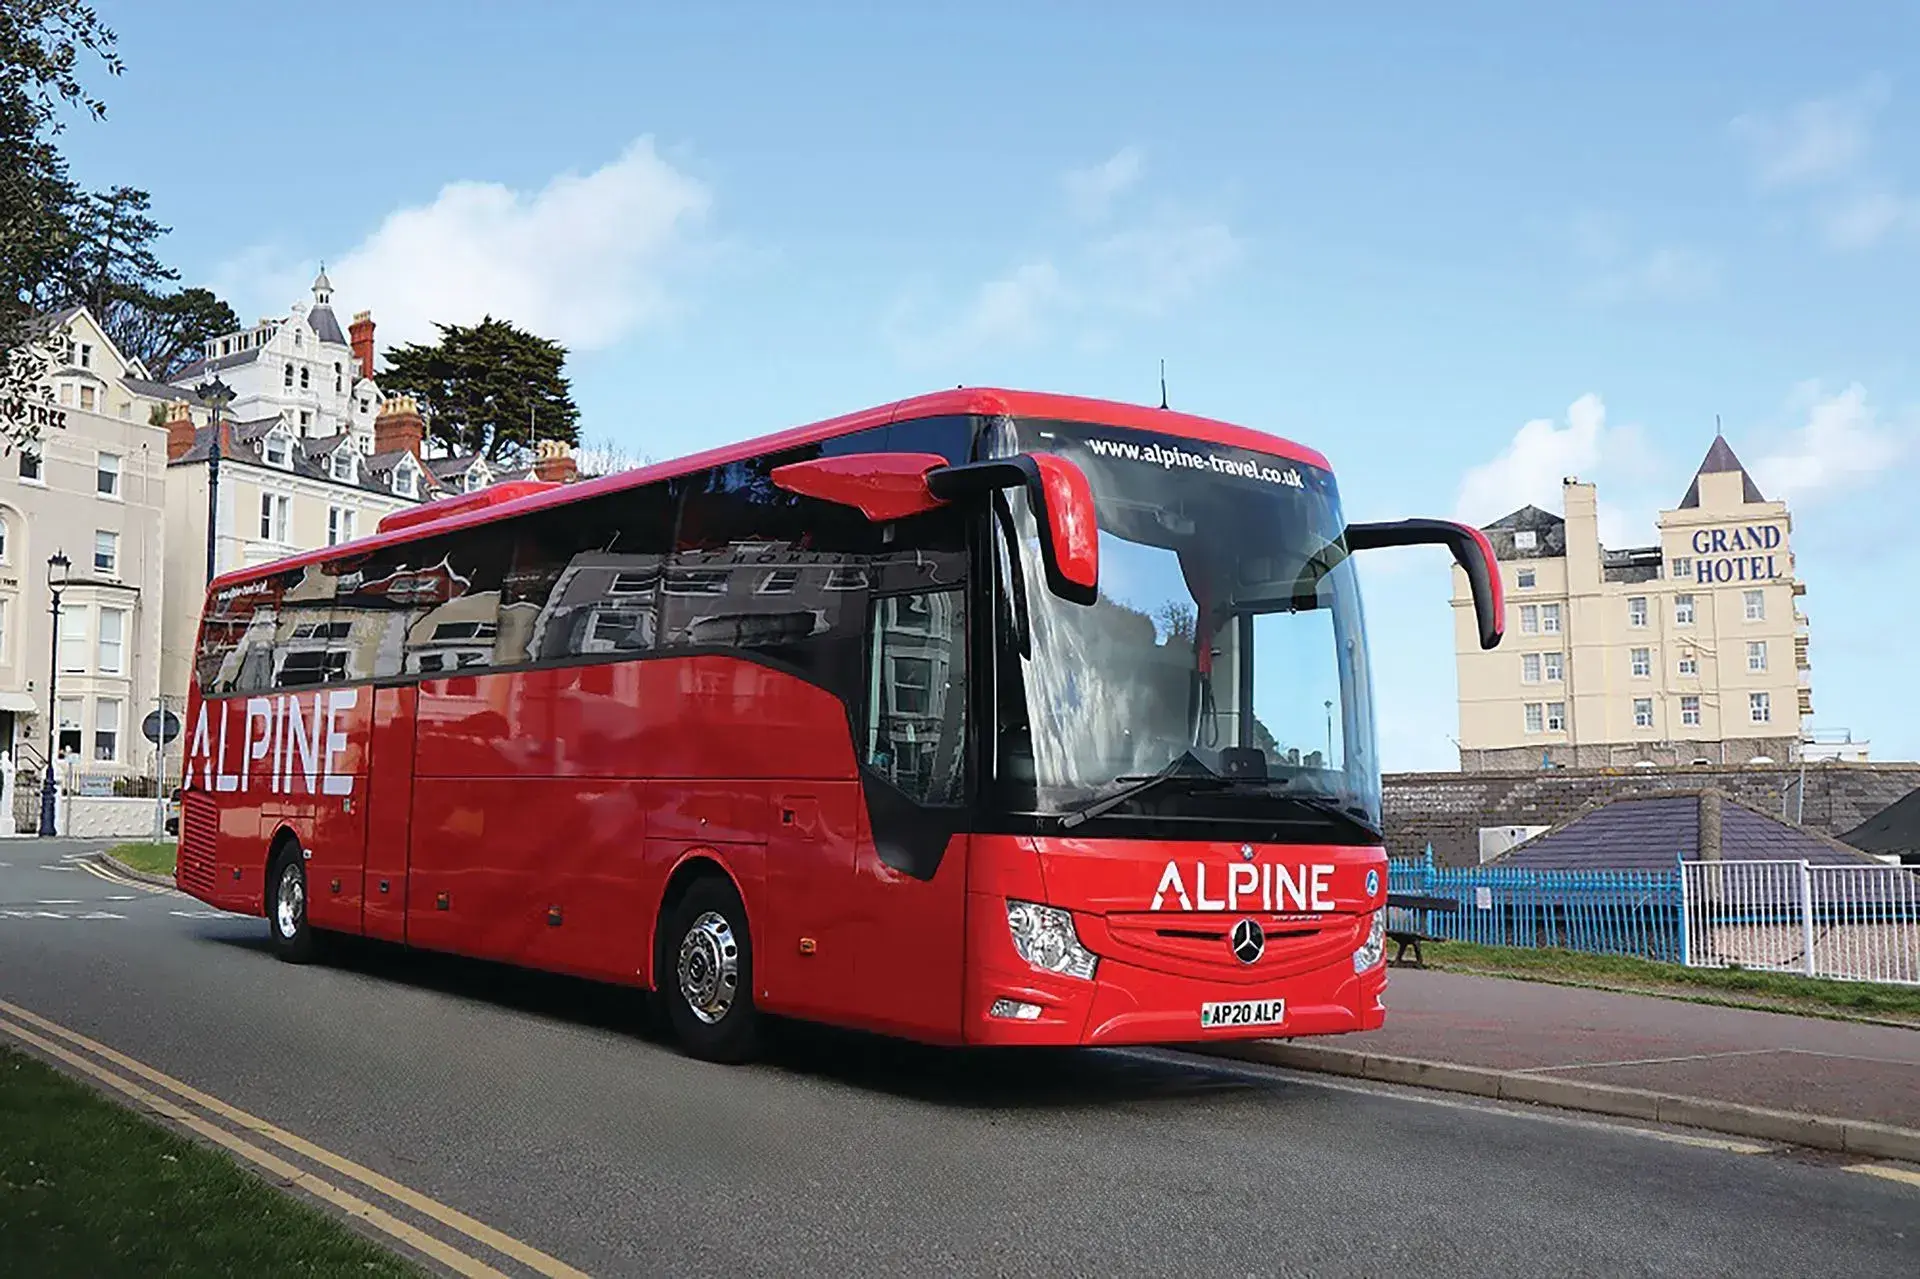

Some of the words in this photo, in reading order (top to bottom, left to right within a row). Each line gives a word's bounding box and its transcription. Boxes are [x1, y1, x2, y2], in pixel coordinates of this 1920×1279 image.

[28, 404, 66, 429] TREE
[1085, 439, 1304, 489] www.alpine-travel.co.uk
[1692, 525, 1780, 554] GRAND
[1696, 555, 1782, 584] HOTEL
[184, 690, 358, 796] ALPINE
[1150, 859, 1336, 911] ALPINE
[1212, 1004, 1251, 1024] AP20
[1254, 1002, 1281, 1021] ALP
